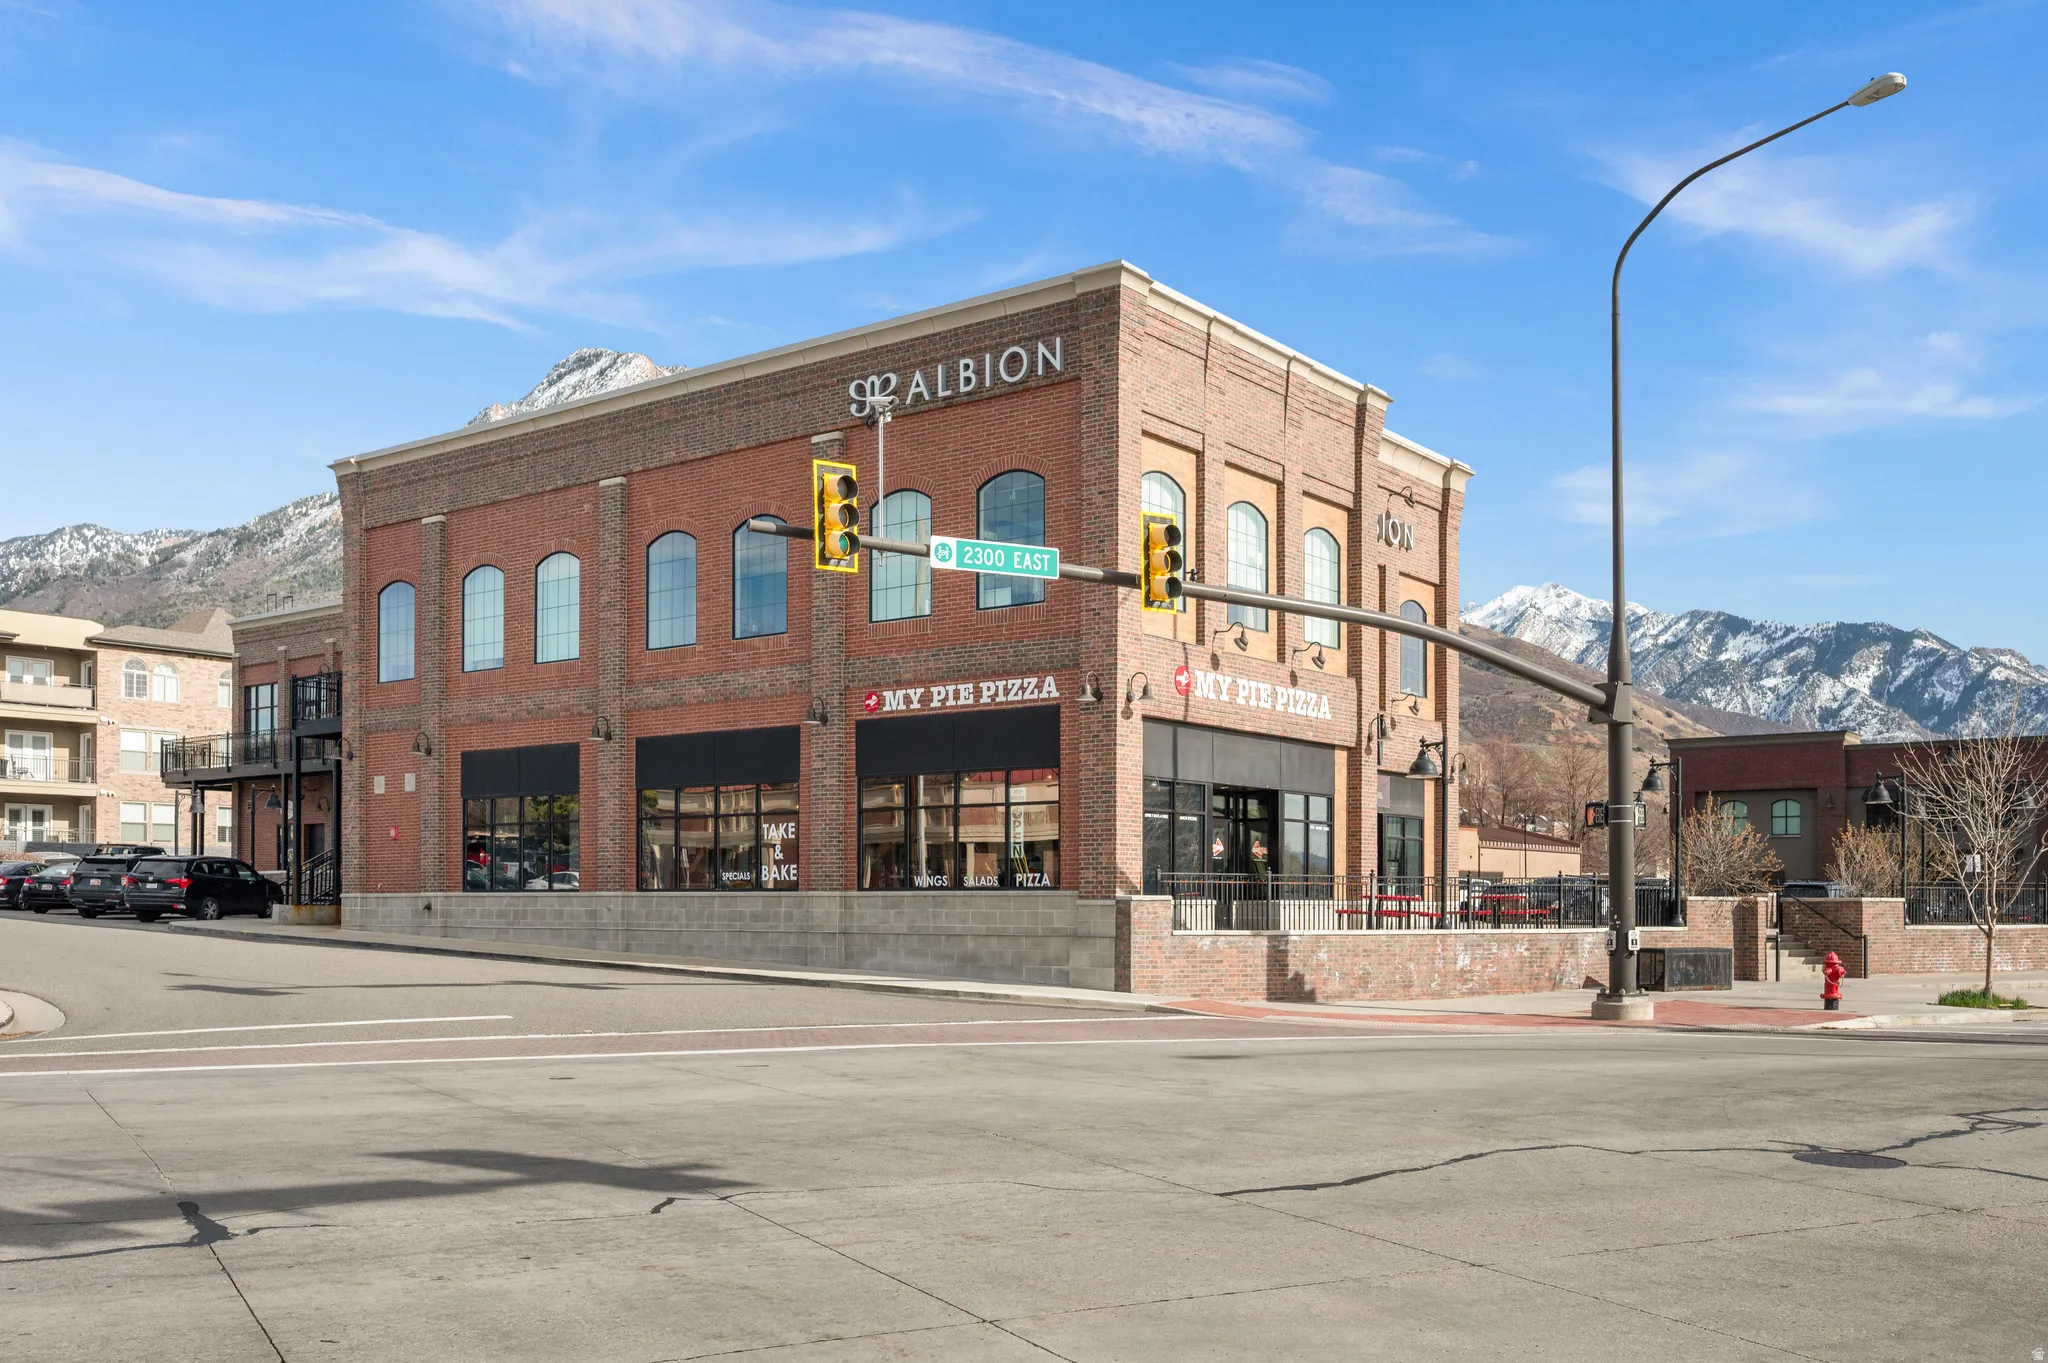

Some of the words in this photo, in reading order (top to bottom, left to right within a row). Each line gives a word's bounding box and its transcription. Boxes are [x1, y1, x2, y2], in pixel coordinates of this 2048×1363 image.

[906, 337, 1063, 405] ALBION
[963, 546, 1005, 567] 2300
[1013, 551, 1051, 572] EAST
[882, 688, 925, 712] MY
[930, 682, 974, 708] PIE
[979, 675, 1060, 704] PIZZA
[1194, 669, 1233, 702] MY
[1236, 677, 1272, 710] PIE
[1273, 684, 1332, 720] PIZZA
[762, 822, 796, 840] TAKE
[774, 844, 784, 860] &
[721, 871, 751, 881] SPECIALS
[761, 864, 798, 881] BAKE
[914, 875, 948, 887] WINGS
[1015, 873, 1051, 887] PIZZA
[963, 876, 999, 887] SALADS
